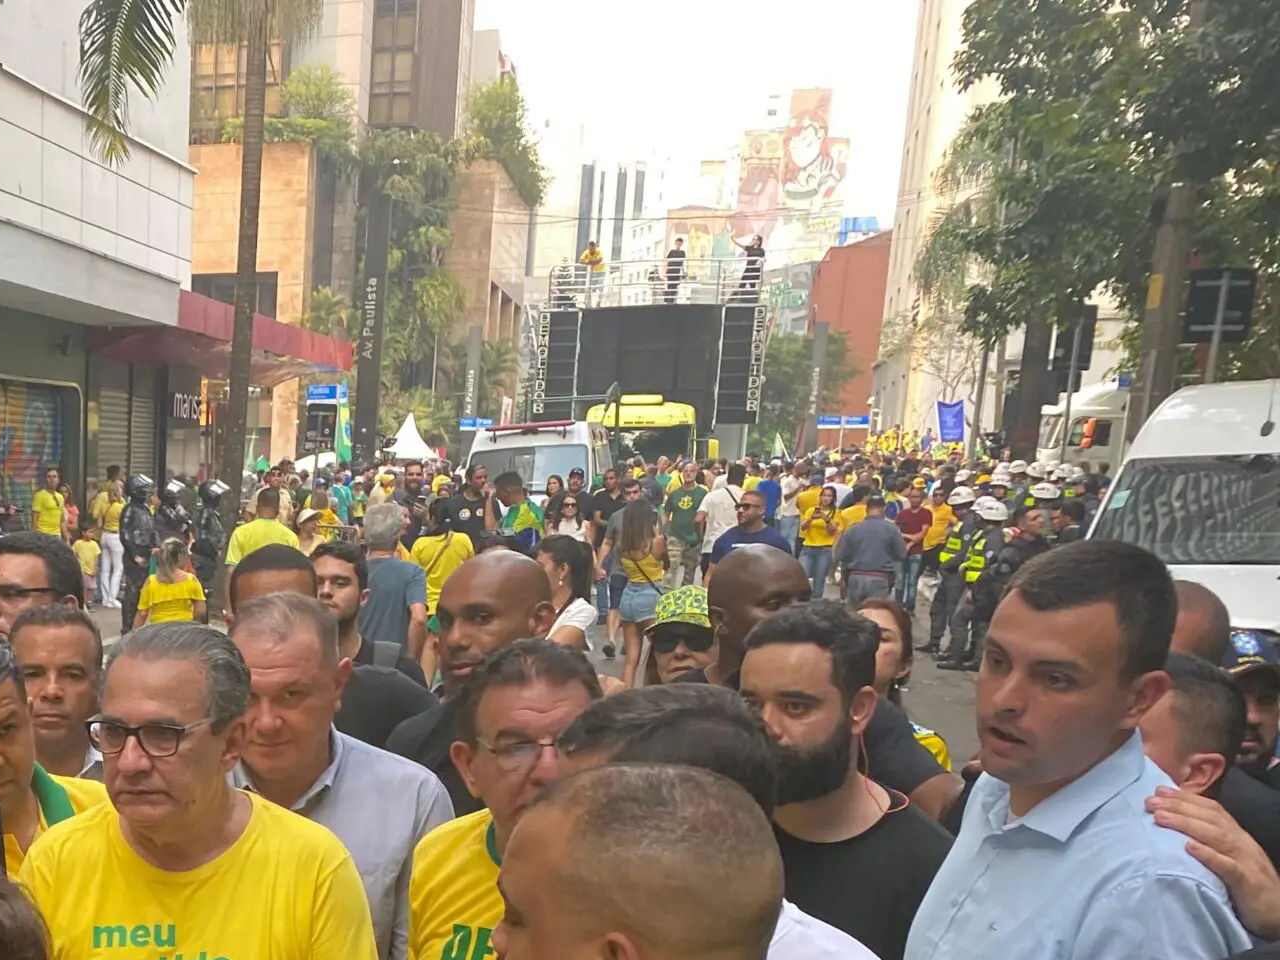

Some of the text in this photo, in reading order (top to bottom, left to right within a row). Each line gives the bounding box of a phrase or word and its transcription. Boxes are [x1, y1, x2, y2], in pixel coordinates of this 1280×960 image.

[361, 277, 378, 360] Av. Paulista
[532, 312, 551, 414] DEMOLIDOR
[745, 307, 766, 412] DEMOLIDOR
[93, 924, 176, 949] meu
